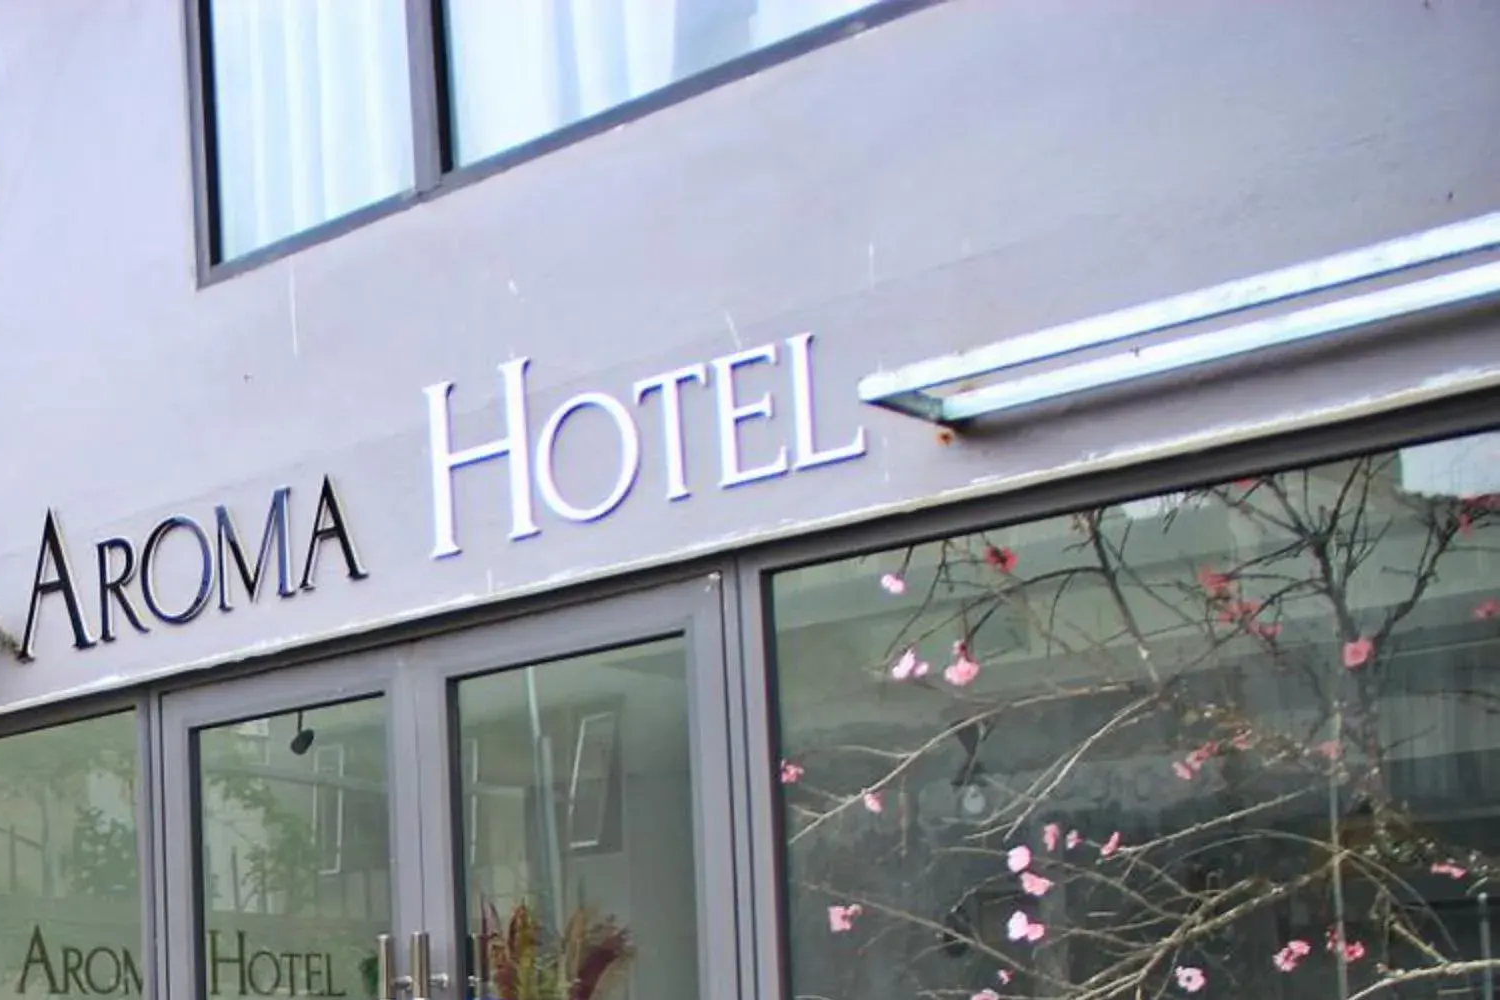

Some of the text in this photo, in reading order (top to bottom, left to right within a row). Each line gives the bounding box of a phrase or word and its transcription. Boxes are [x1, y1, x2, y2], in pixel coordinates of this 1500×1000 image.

[16, 331, 867, 662] AROMA HOTEL
[15, 924, 347, 998] AROM HOTEL
